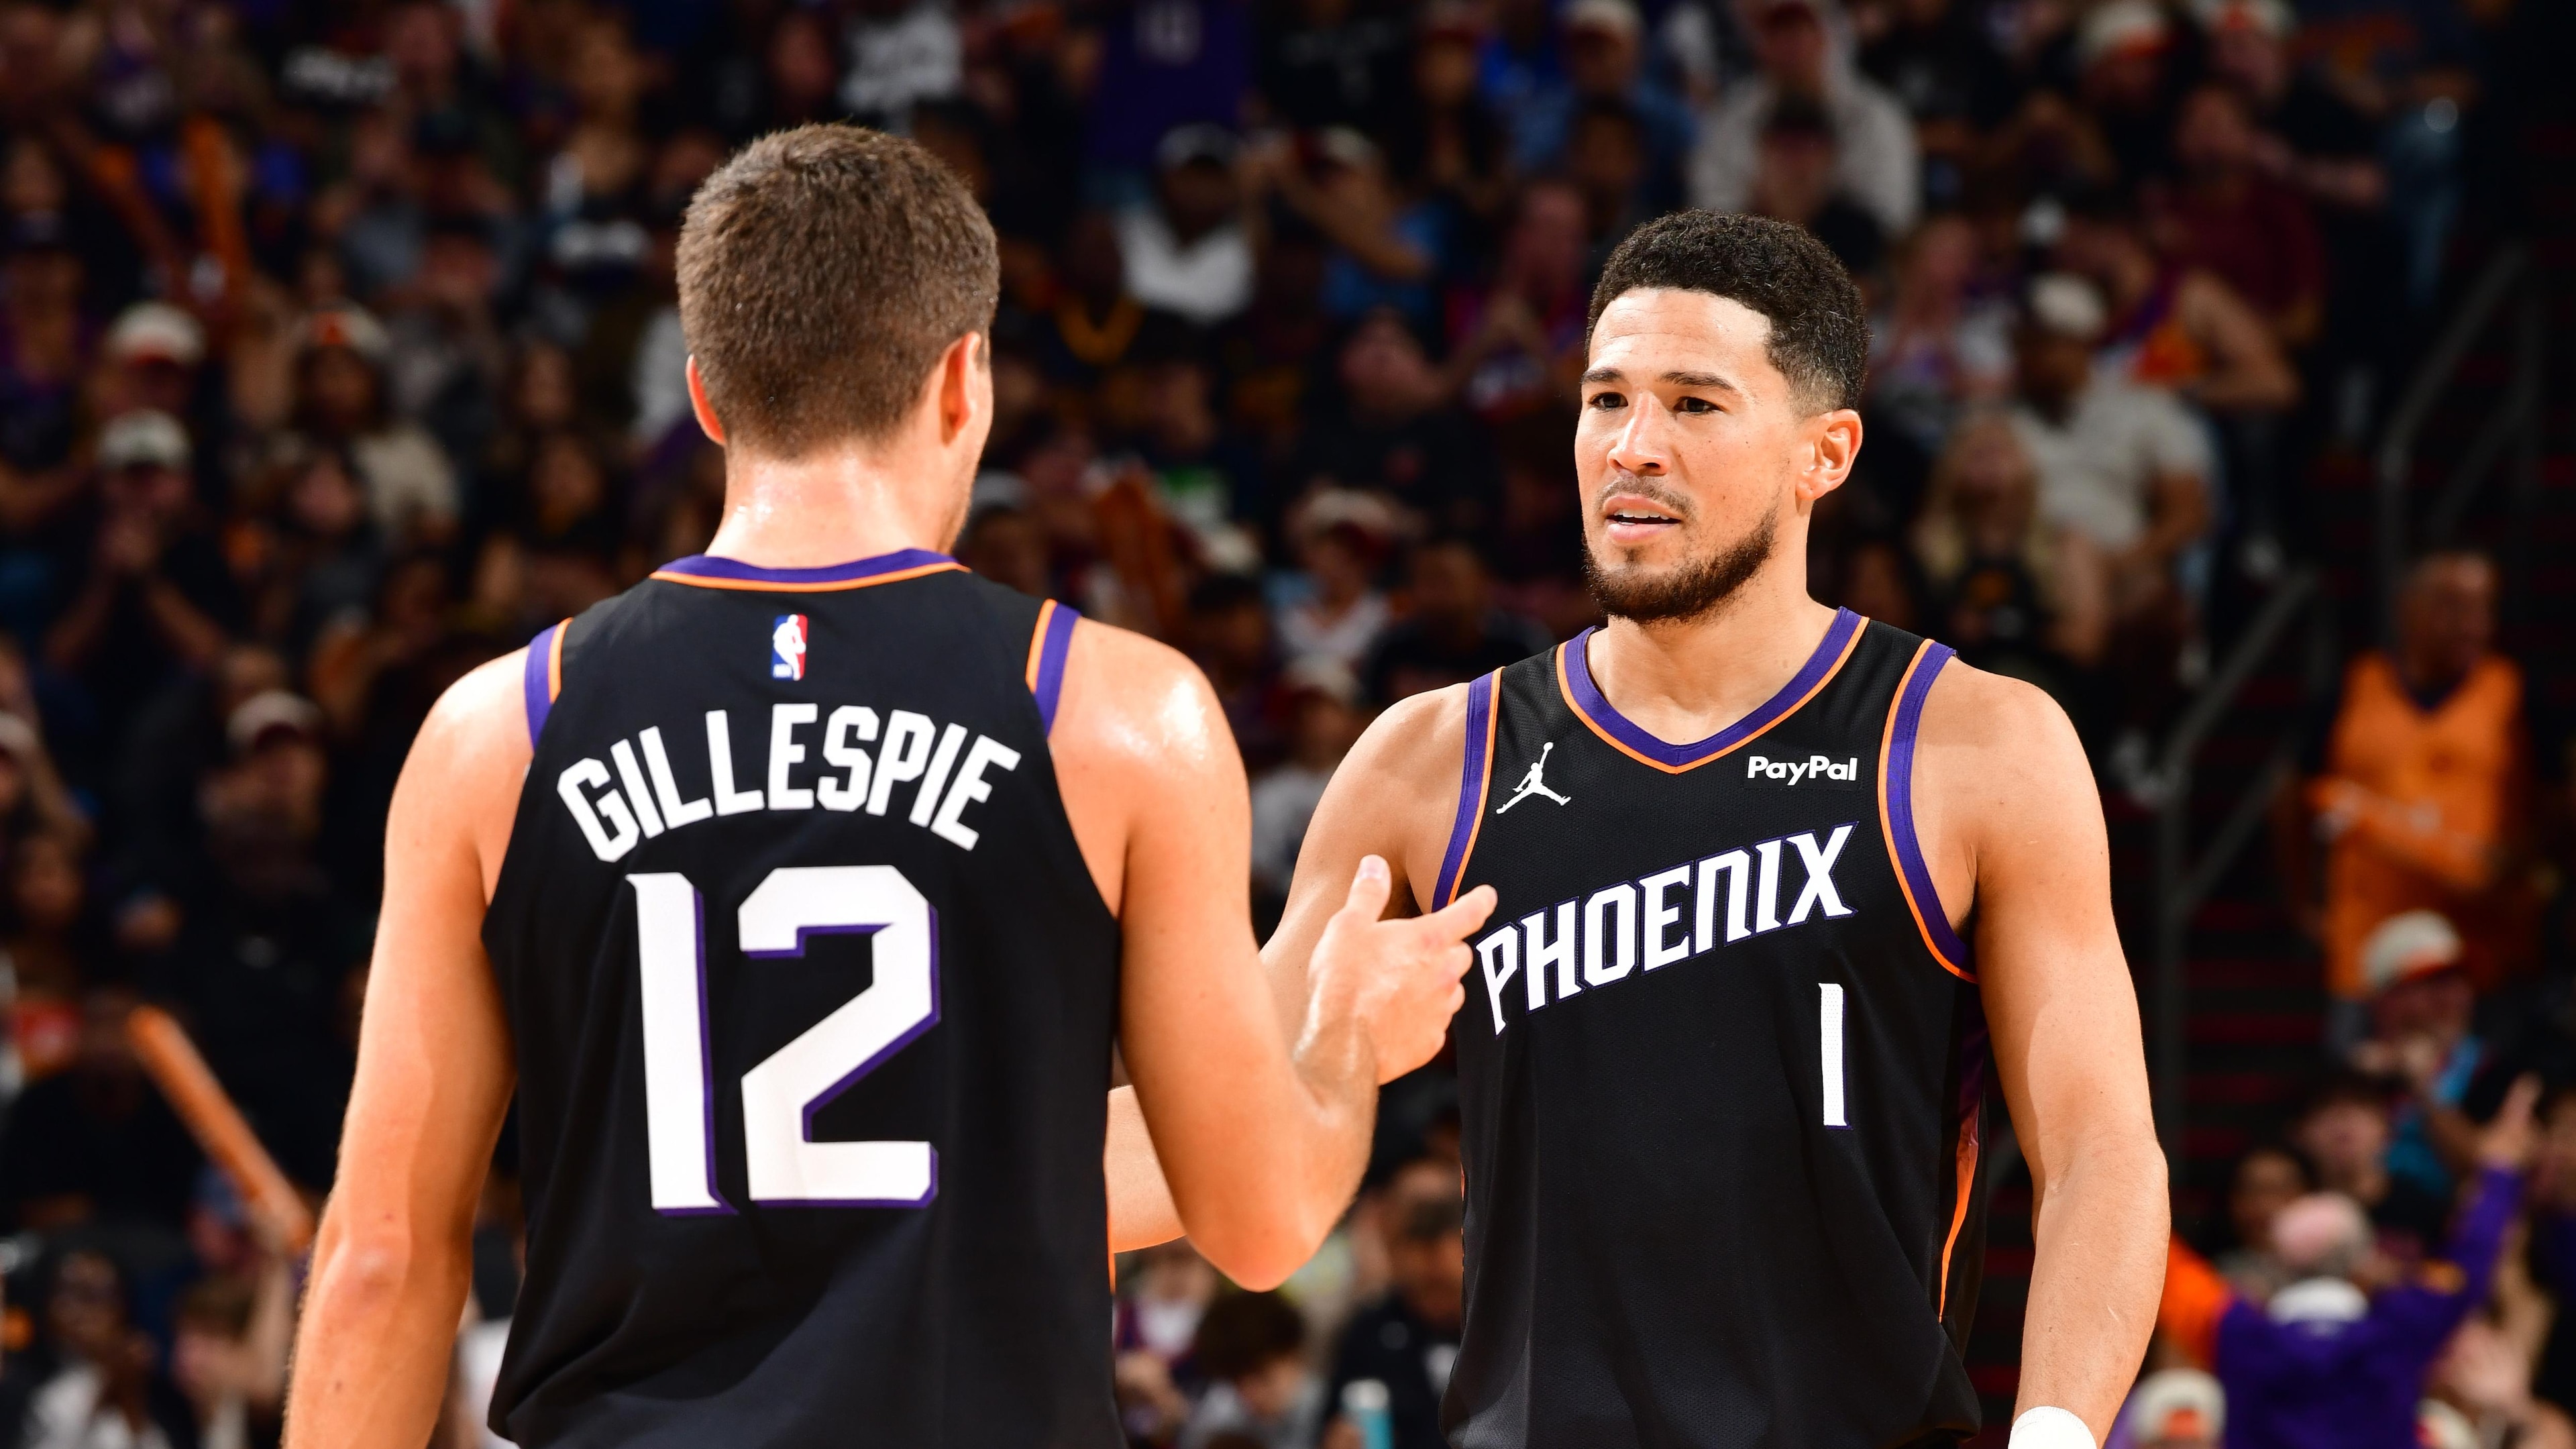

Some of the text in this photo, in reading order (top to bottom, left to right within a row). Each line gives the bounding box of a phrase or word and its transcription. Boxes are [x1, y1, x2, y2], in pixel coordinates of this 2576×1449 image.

[556, 702, 1022, 863] GILLESPIE
[1747, 755, 1858, 786] PayPal
[1474, 822, 1858, 1037] PHOENIX
[625, 865, 939, 1214] 12
[1817, 982, 1849, 1128] 1
